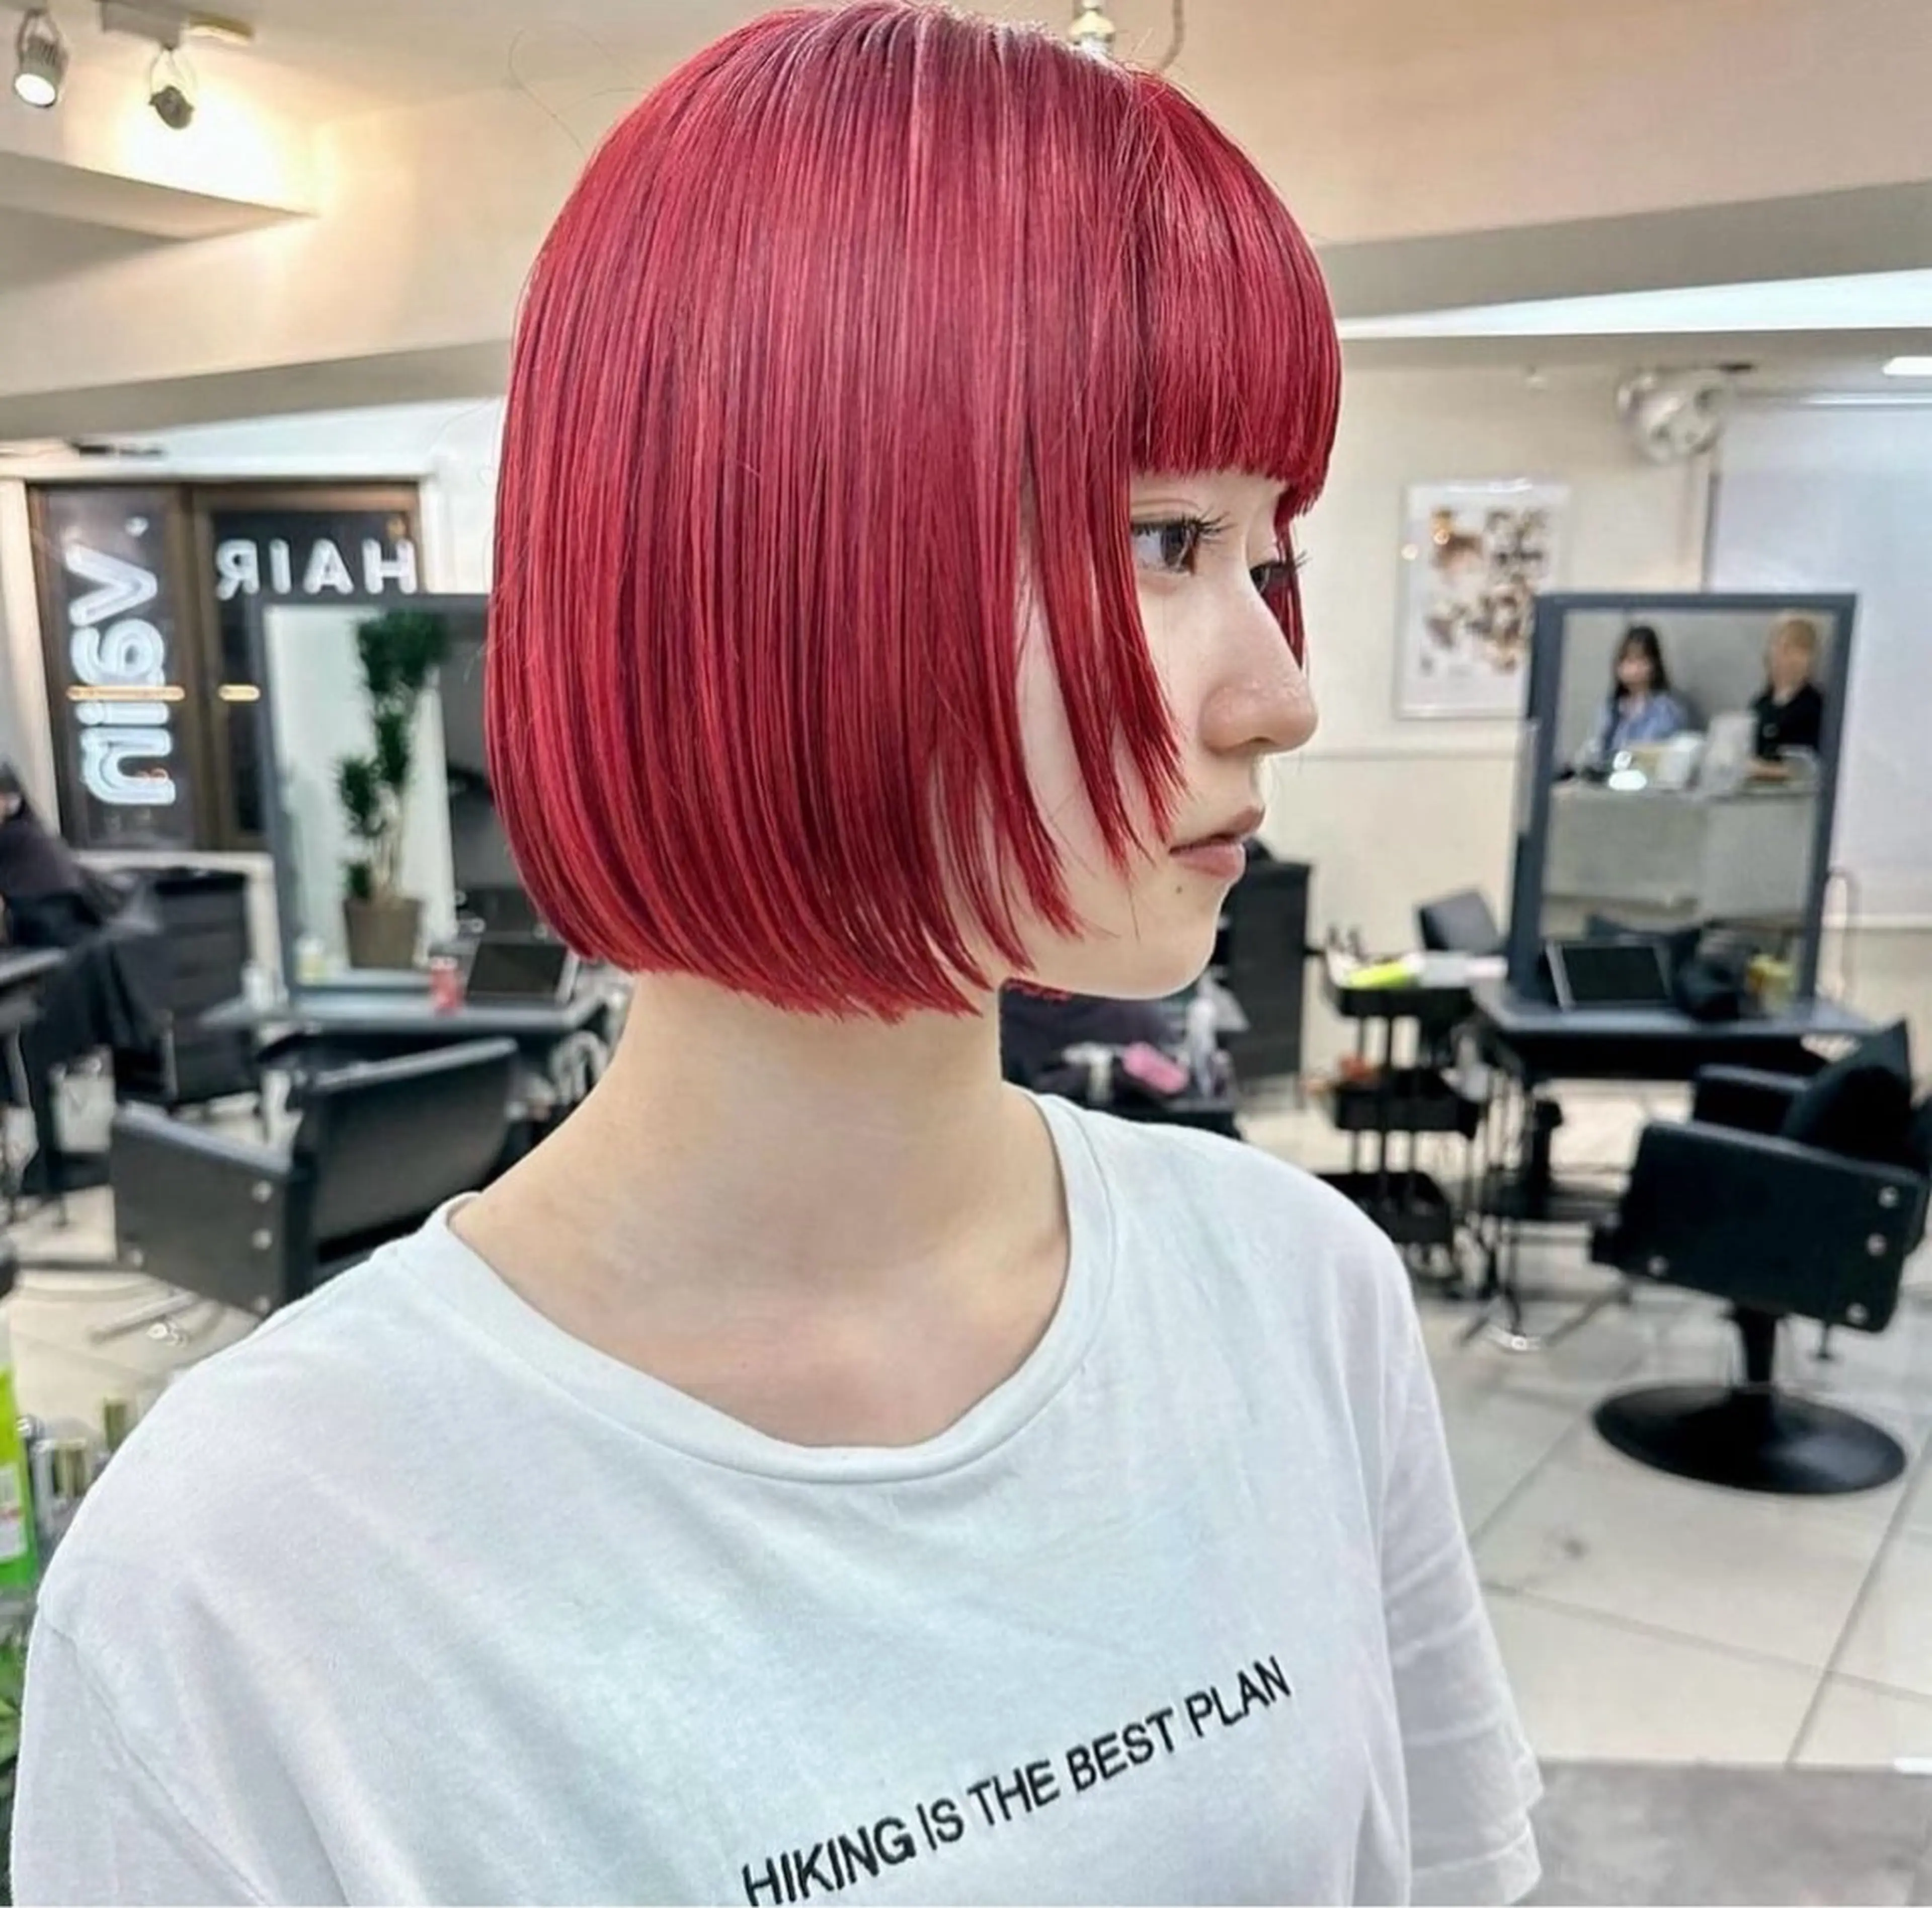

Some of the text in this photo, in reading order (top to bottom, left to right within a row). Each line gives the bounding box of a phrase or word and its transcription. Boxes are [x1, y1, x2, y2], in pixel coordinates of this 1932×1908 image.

[742, 1655, 1291, 1907] HIKING IS THE BEST PLAN
